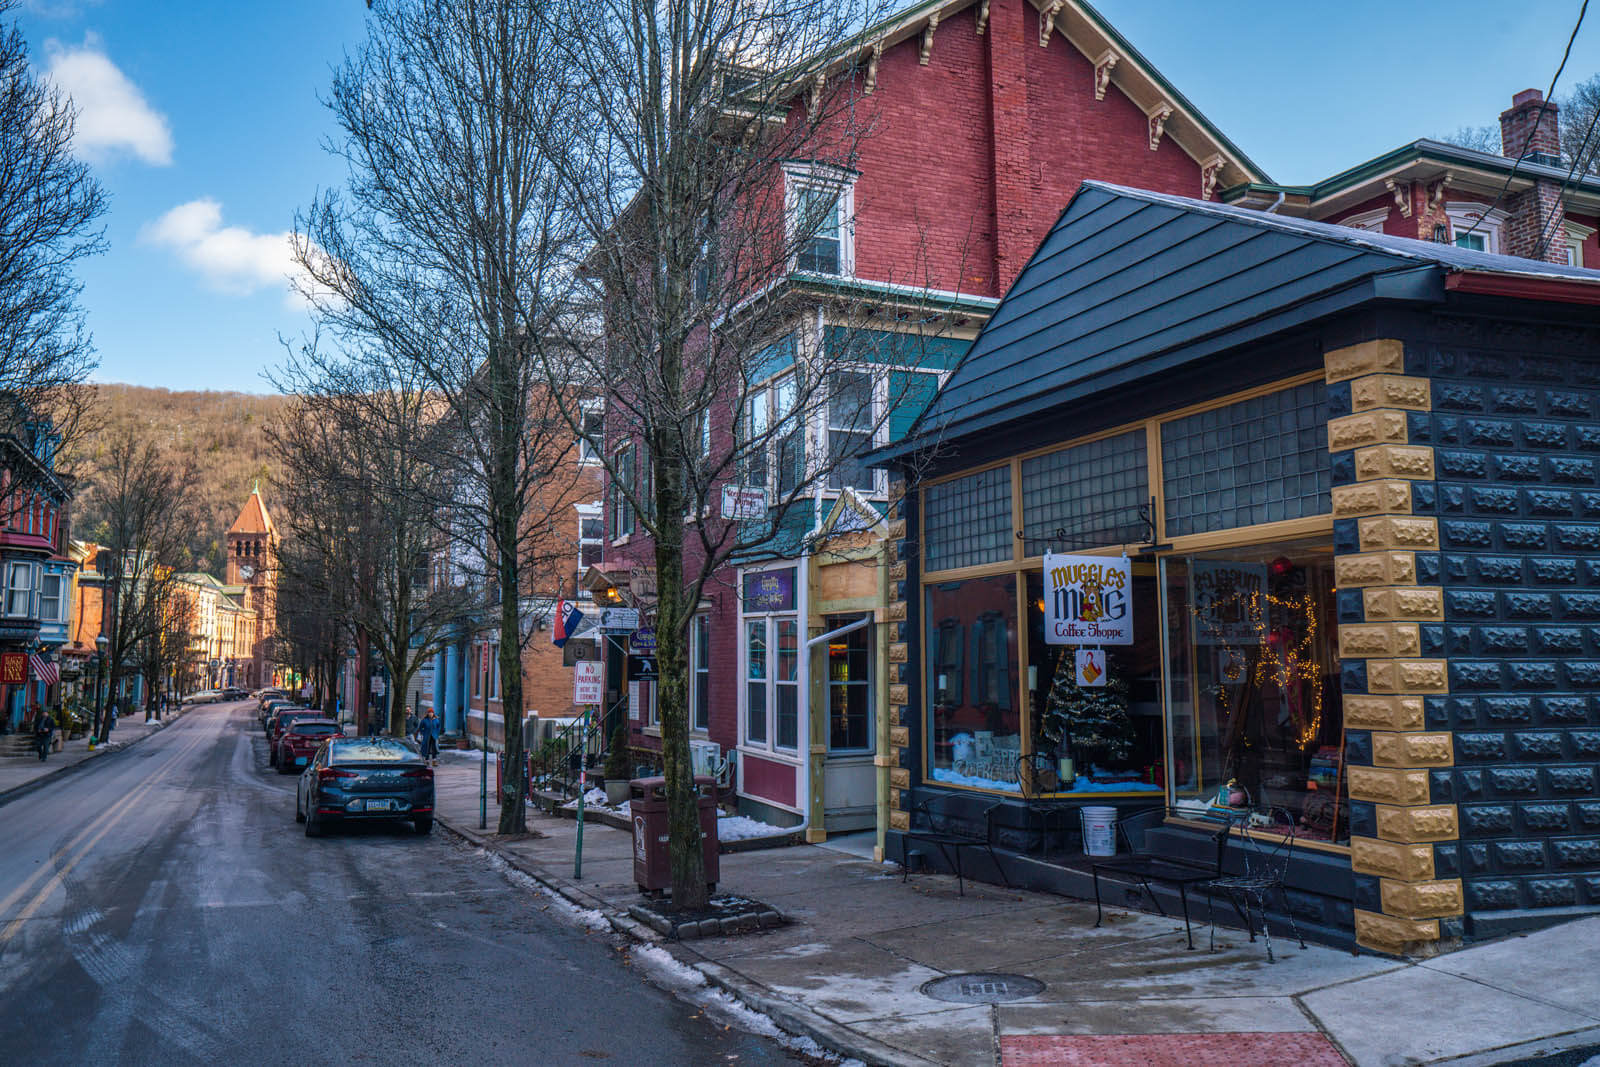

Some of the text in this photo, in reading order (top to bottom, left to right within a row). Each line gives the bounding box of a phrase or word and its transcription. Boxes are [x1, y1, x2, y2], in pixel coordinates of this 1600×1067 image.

[1055, 622, 1125, 639] Coffee Shoppe
[586, 666, 595, 674] NO
[578, 676, 600, 684] PARKING
